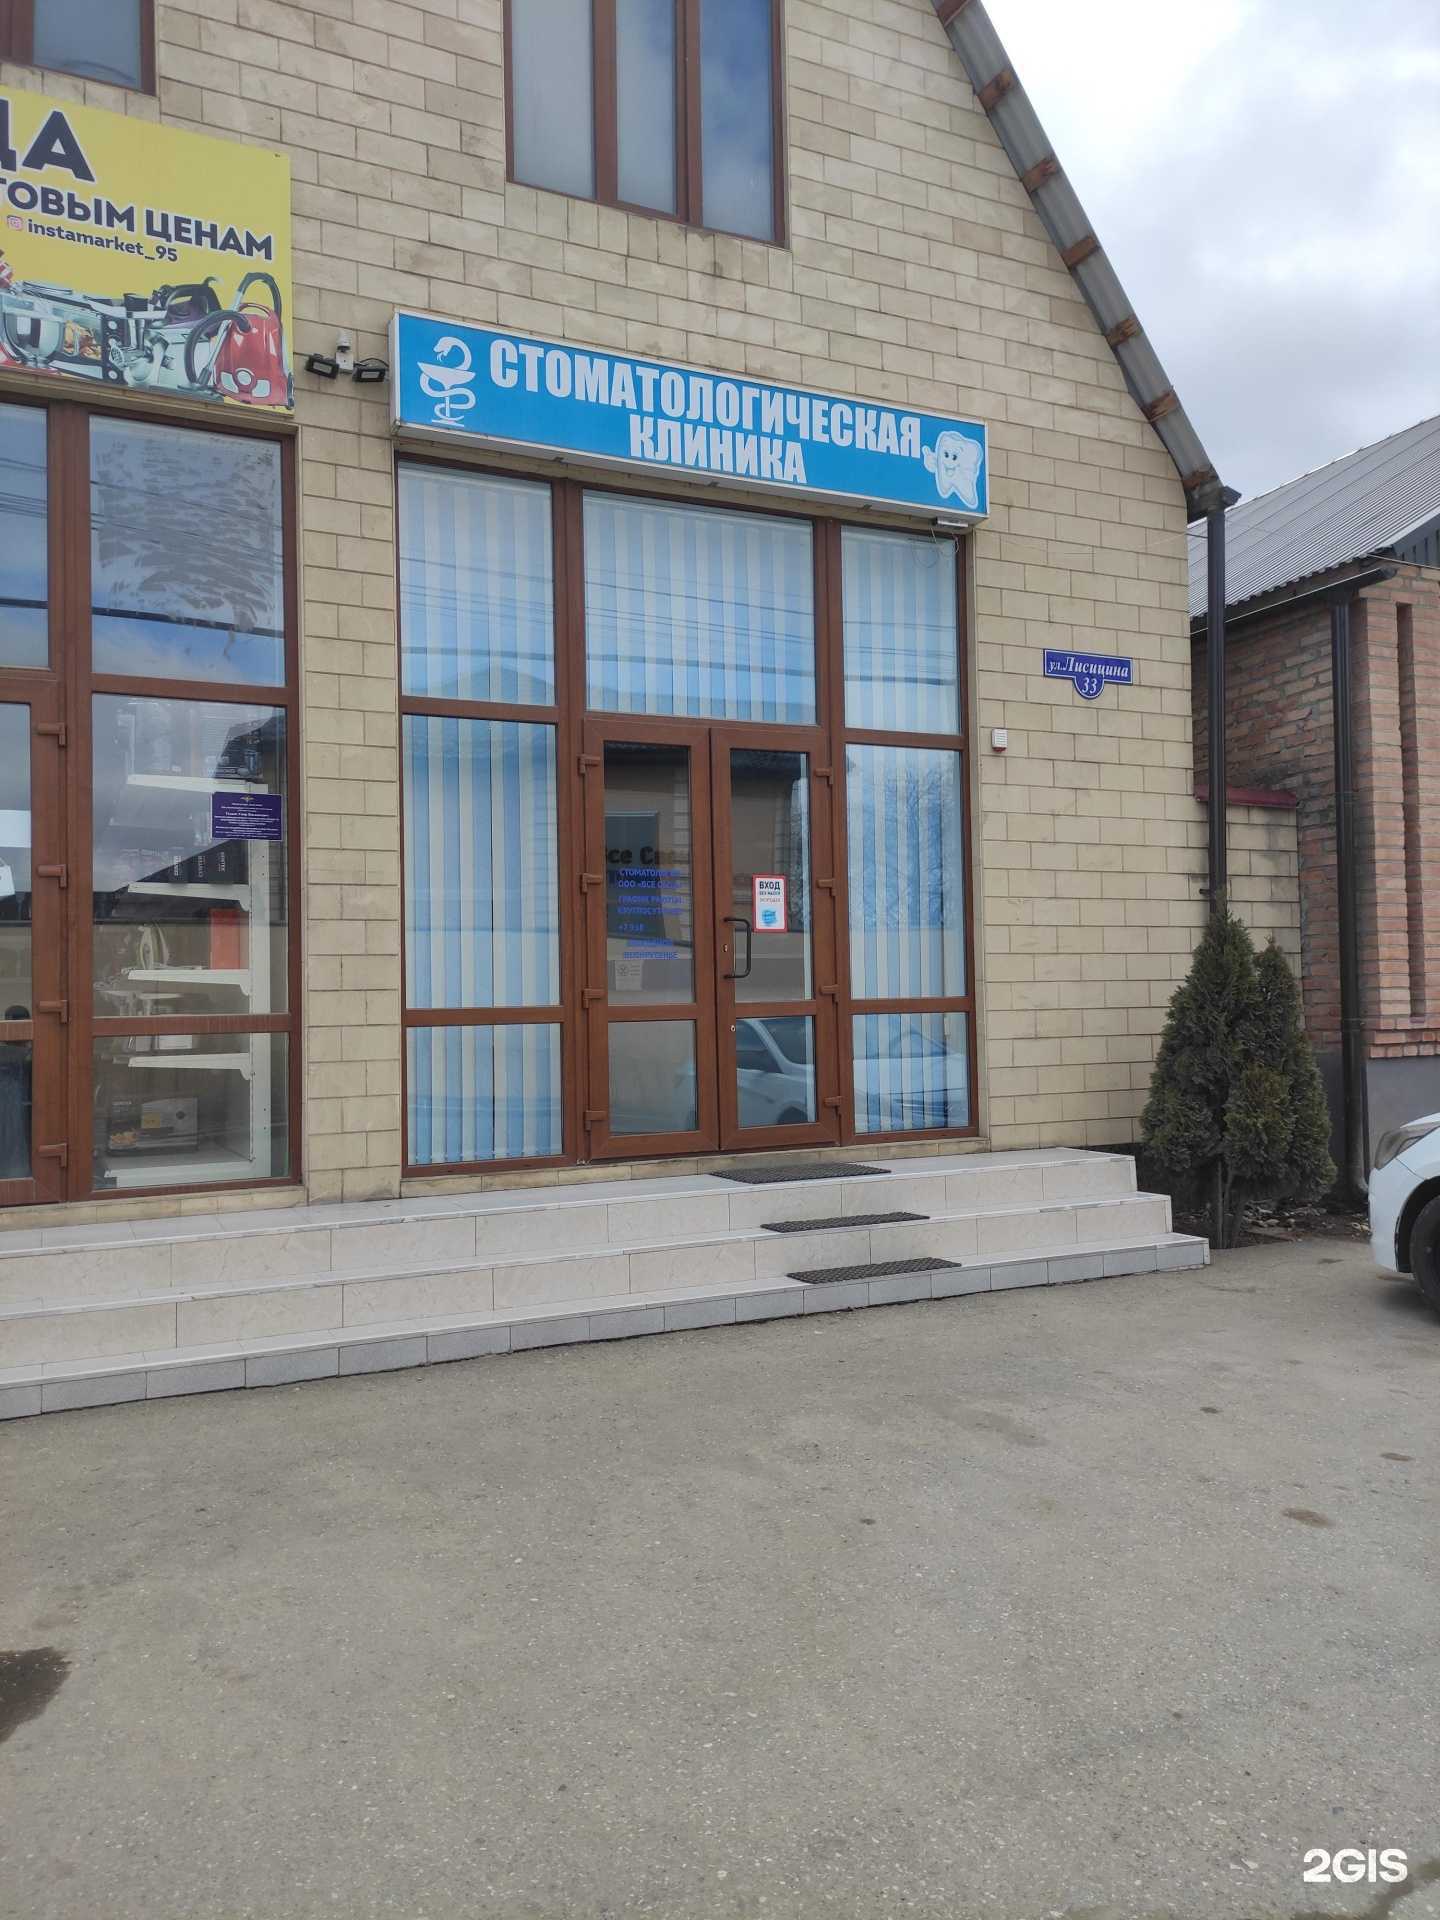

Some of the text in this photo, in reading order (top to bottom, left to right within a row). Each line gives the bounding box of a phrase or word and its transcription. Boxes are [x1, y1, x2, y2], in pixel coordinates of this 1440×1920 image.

[27, 218, 178, 262] instamarket_95
[145, 208, 272, 261] ЦЕНАМ
[490, 338, 921, 459] СТОМАТОЛОГИЧЕСКАЯ
[629, 413, 808, 484] КЛИНИКА
[1081, 676, 1098, 694] 33
[759, 880, 781, 891] ВХОД
